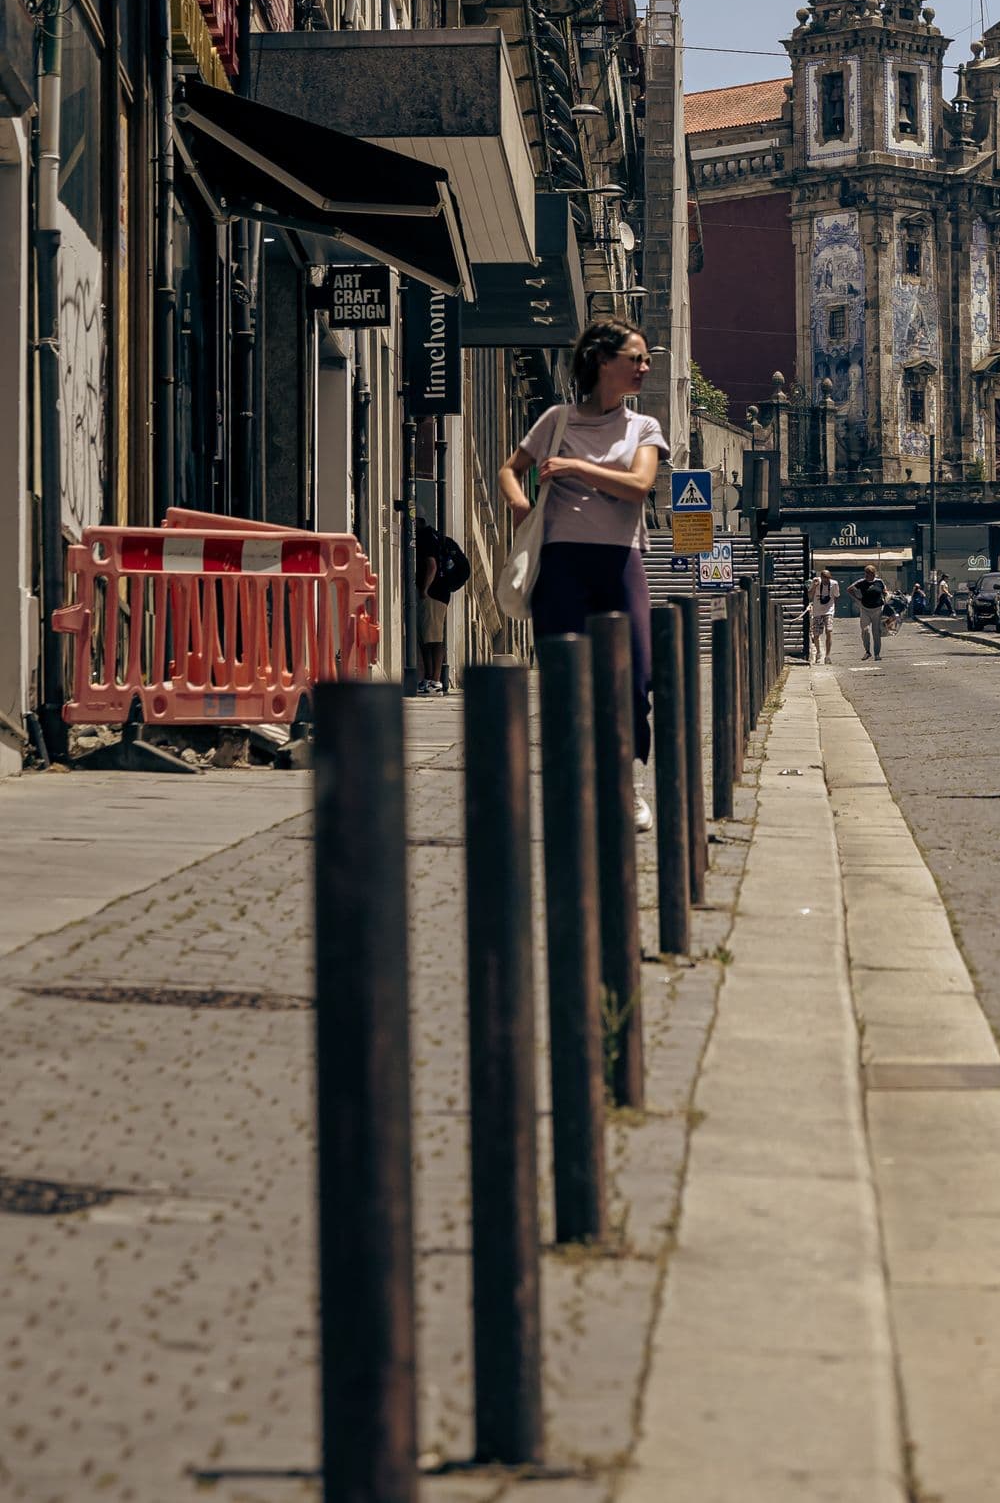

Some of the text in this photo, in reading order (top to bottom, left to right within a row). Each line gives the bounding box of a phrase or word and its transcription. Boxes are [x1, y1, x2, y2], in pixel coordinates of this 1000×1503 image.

[334, 274, 362, 289] ART
[334, 289, 381, 304] CRAFT
[334, 304, 386, 320] DESIGN
[830, 536, 869, 546] ABILINI
